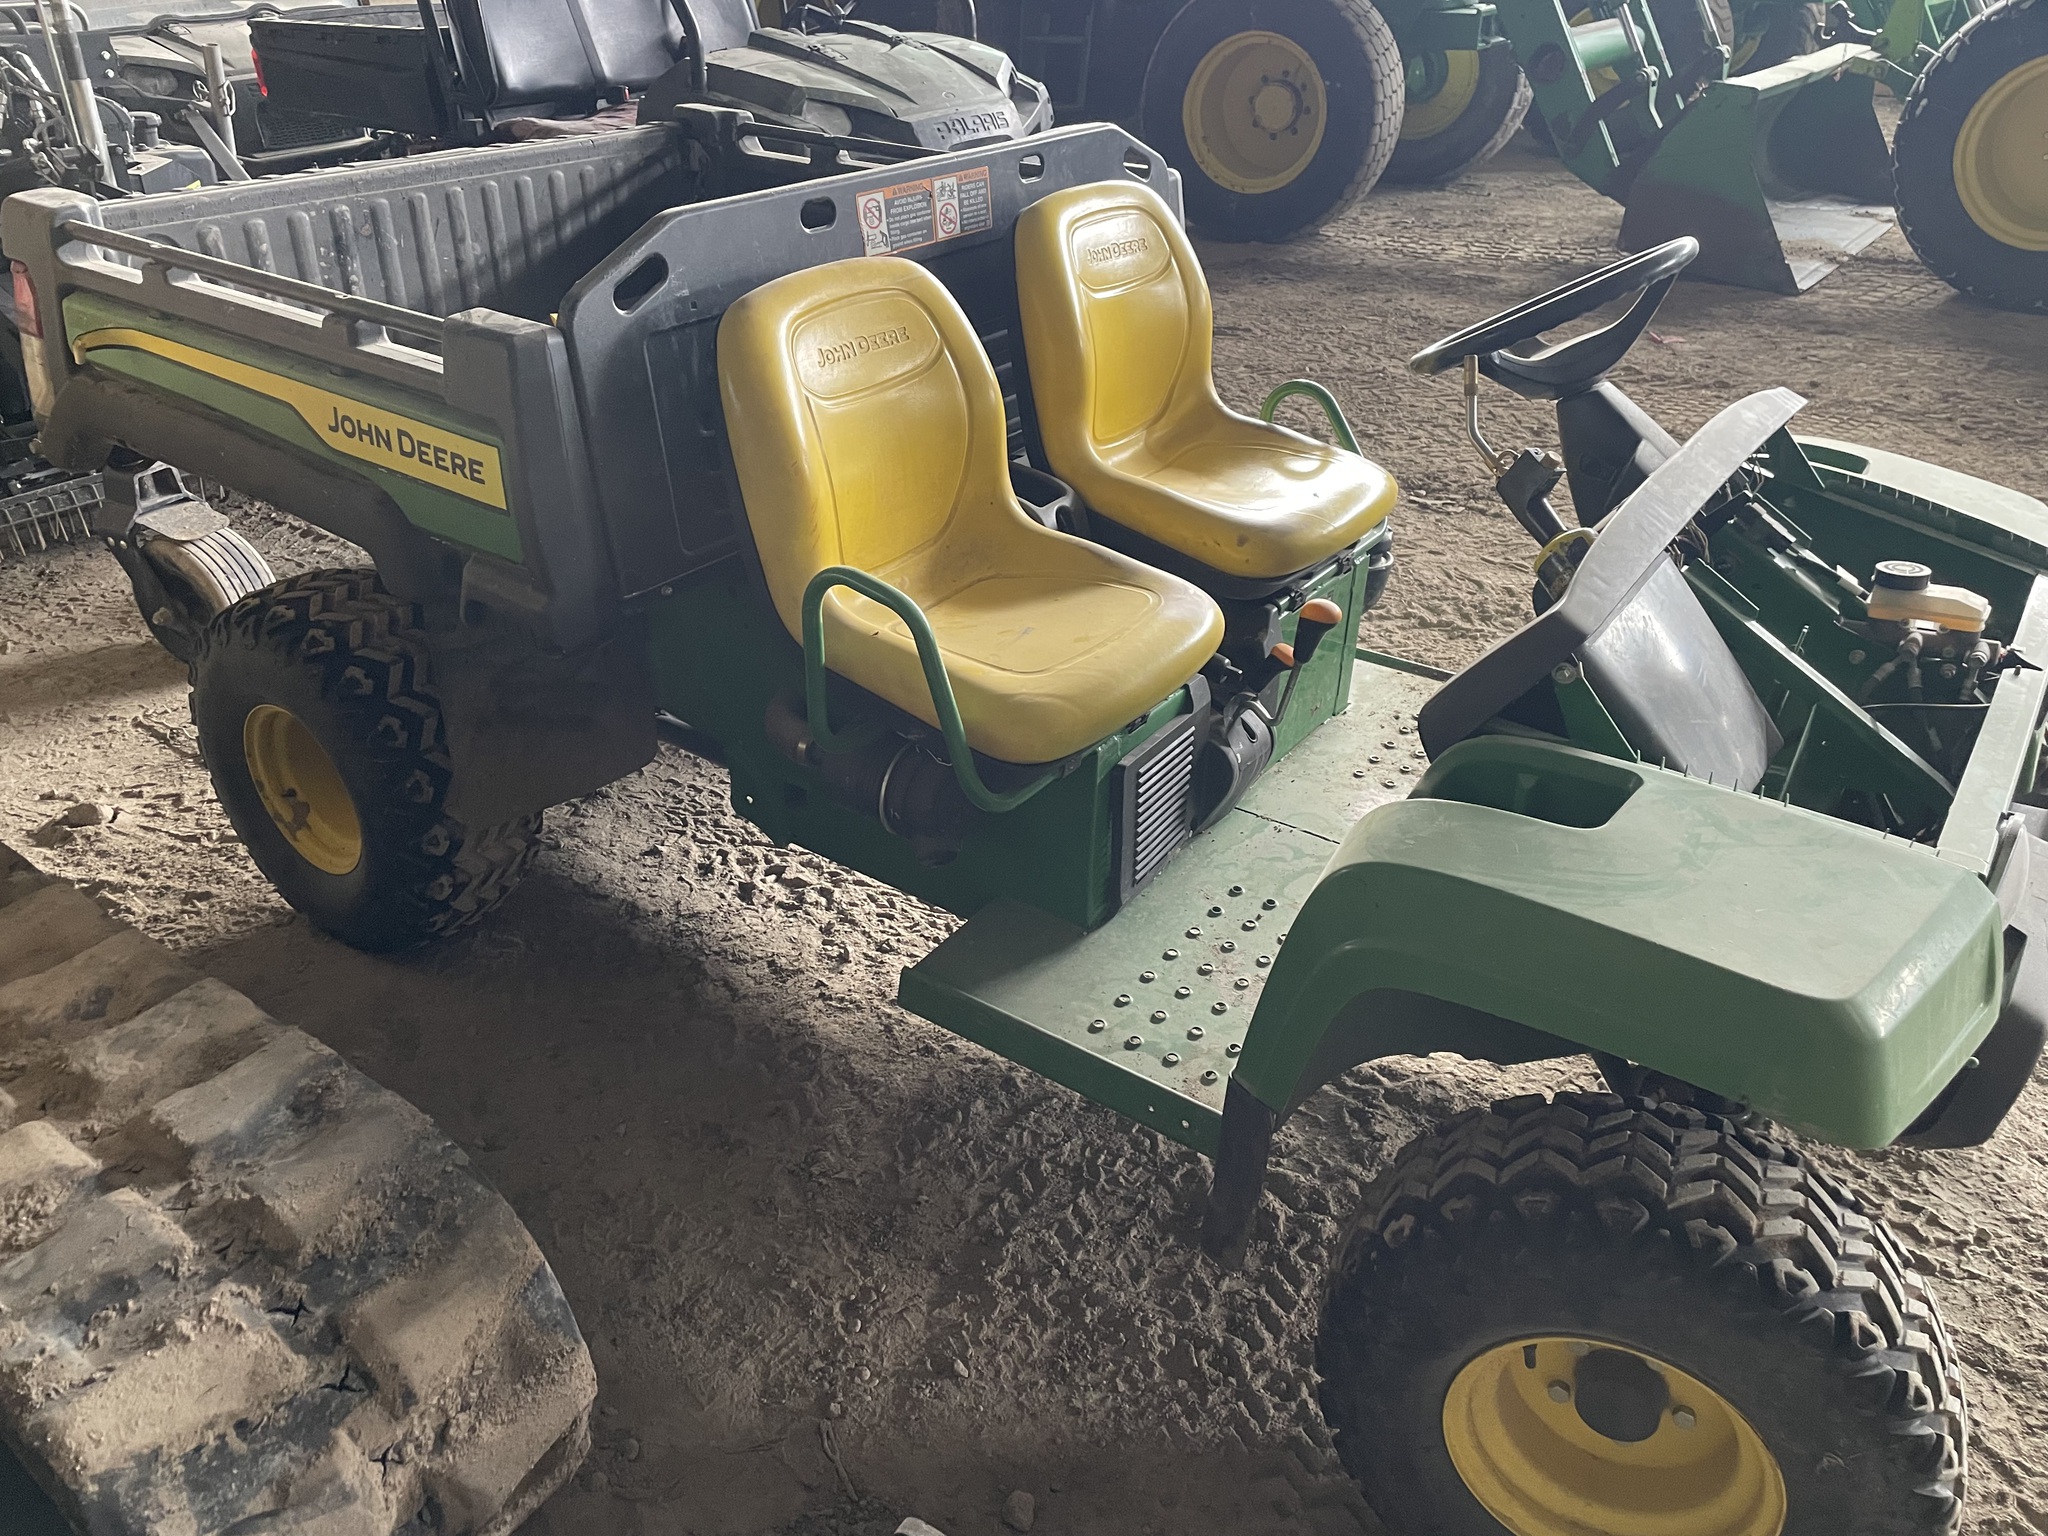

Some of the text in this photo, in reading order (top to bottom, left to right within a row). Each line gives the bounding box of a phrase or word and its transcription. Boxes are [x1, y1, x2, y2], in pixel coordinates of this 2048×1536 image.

[933, 111, 1010, 140] POLARIS
[897, 183, 924, 195] WARNING
[1087, 238, 1148, 266] JOHN DEERE
[817, 326, 910, 368] JOHN DEERE
[328, 406, 486, 485] JOHN DEERE
